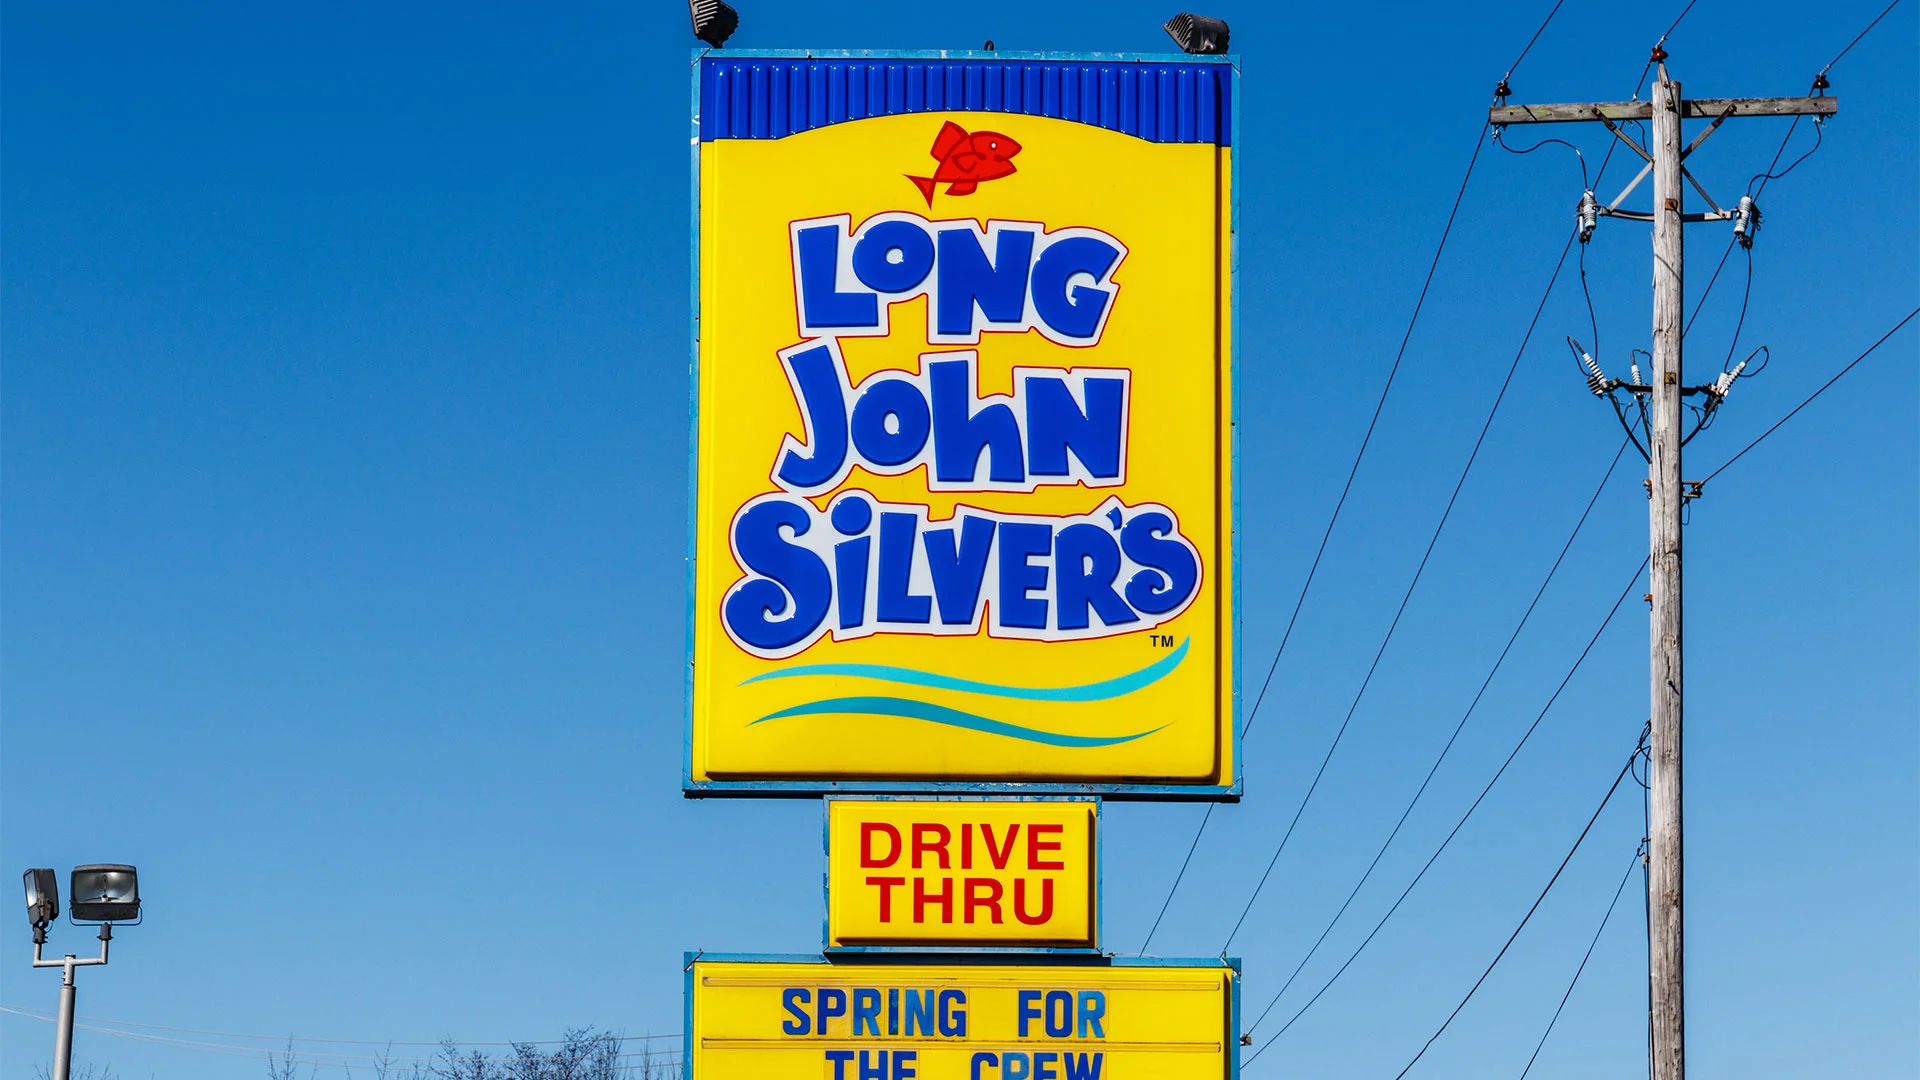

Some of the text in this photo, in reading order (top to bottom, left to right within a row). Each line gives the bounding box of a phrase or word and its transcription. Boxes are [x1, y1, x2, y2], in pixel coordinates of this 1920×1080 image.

[796, 220, 1120, 338] LONG
[1149, 635, 1174, 648] TM
[860, 822, 1065, 871] DRIVE
[865, 876, 1054, 926] THRU
[782, 988, 1106, 1038] SPRING FOR
[825, 1050, 917, 1080] THE
